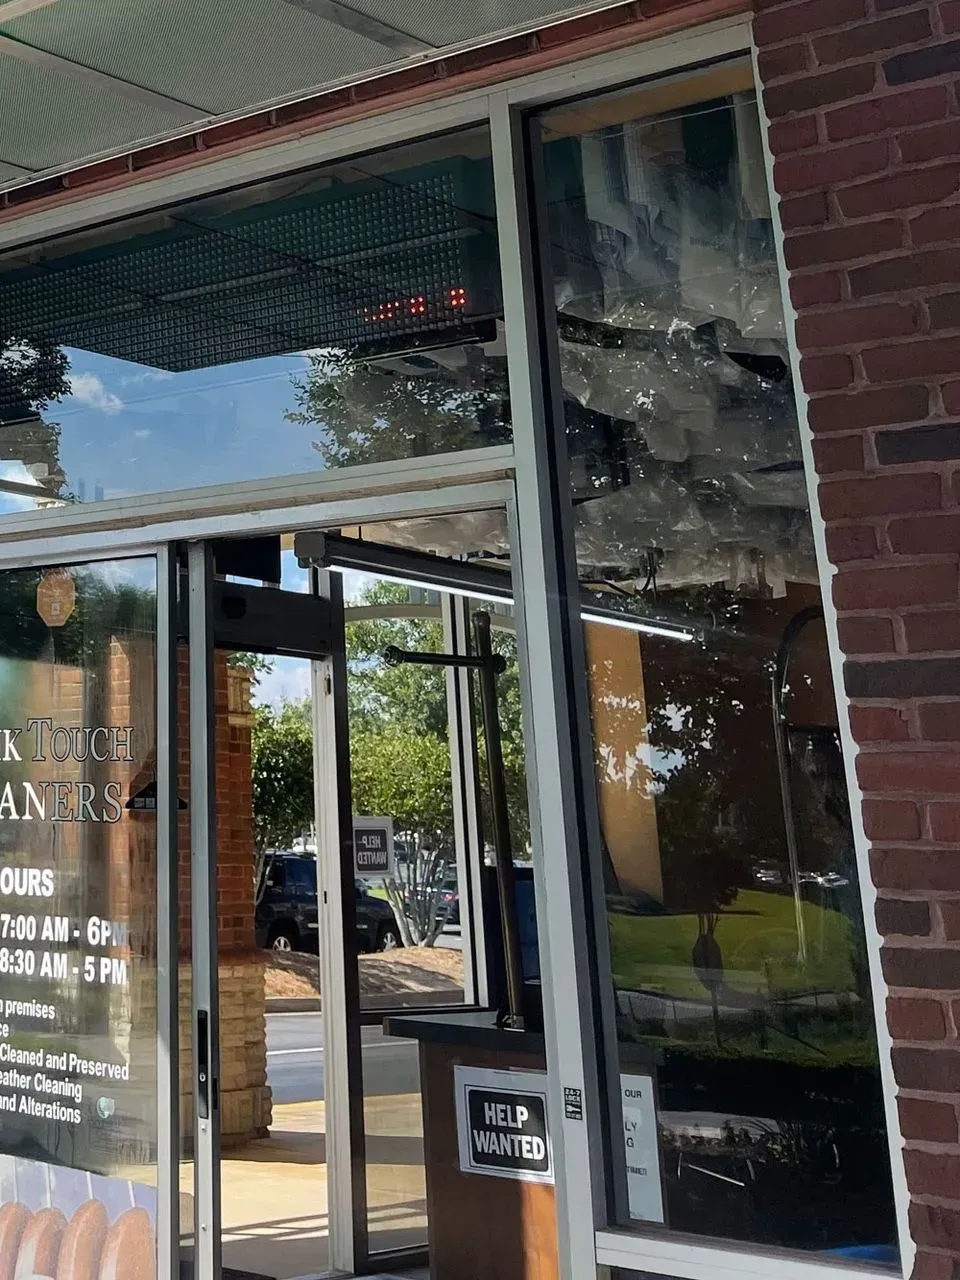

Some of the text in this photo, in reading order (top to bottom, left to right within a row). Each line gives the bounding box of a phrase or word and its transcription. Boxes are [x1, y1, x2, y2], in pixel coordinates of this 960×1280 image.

[27, 717, 135, 762] TOUCH
[0, 913, 36, 941] 7:00
[41, 916, 69, 943] AM
[0, 947, 35, 975] 8:30
[40, 951, 67, 979] AM
[84, 955, 95, 982] 5
[100, 957, 127, 985] PM
[5, 998, 55, 1019] premises
[0, 1043, 43, 1067] Cleaned
[46, 1052, 67, 1071] and
[69, 1056, 130, 1081] Preserved
[34, 1073, 83, 1102] Cleaning
[19, 1099, 81, 1124] Alterations
[484, 1101, 529, 1129] HELP
[473, 1129, 546, 1161] WANTED
